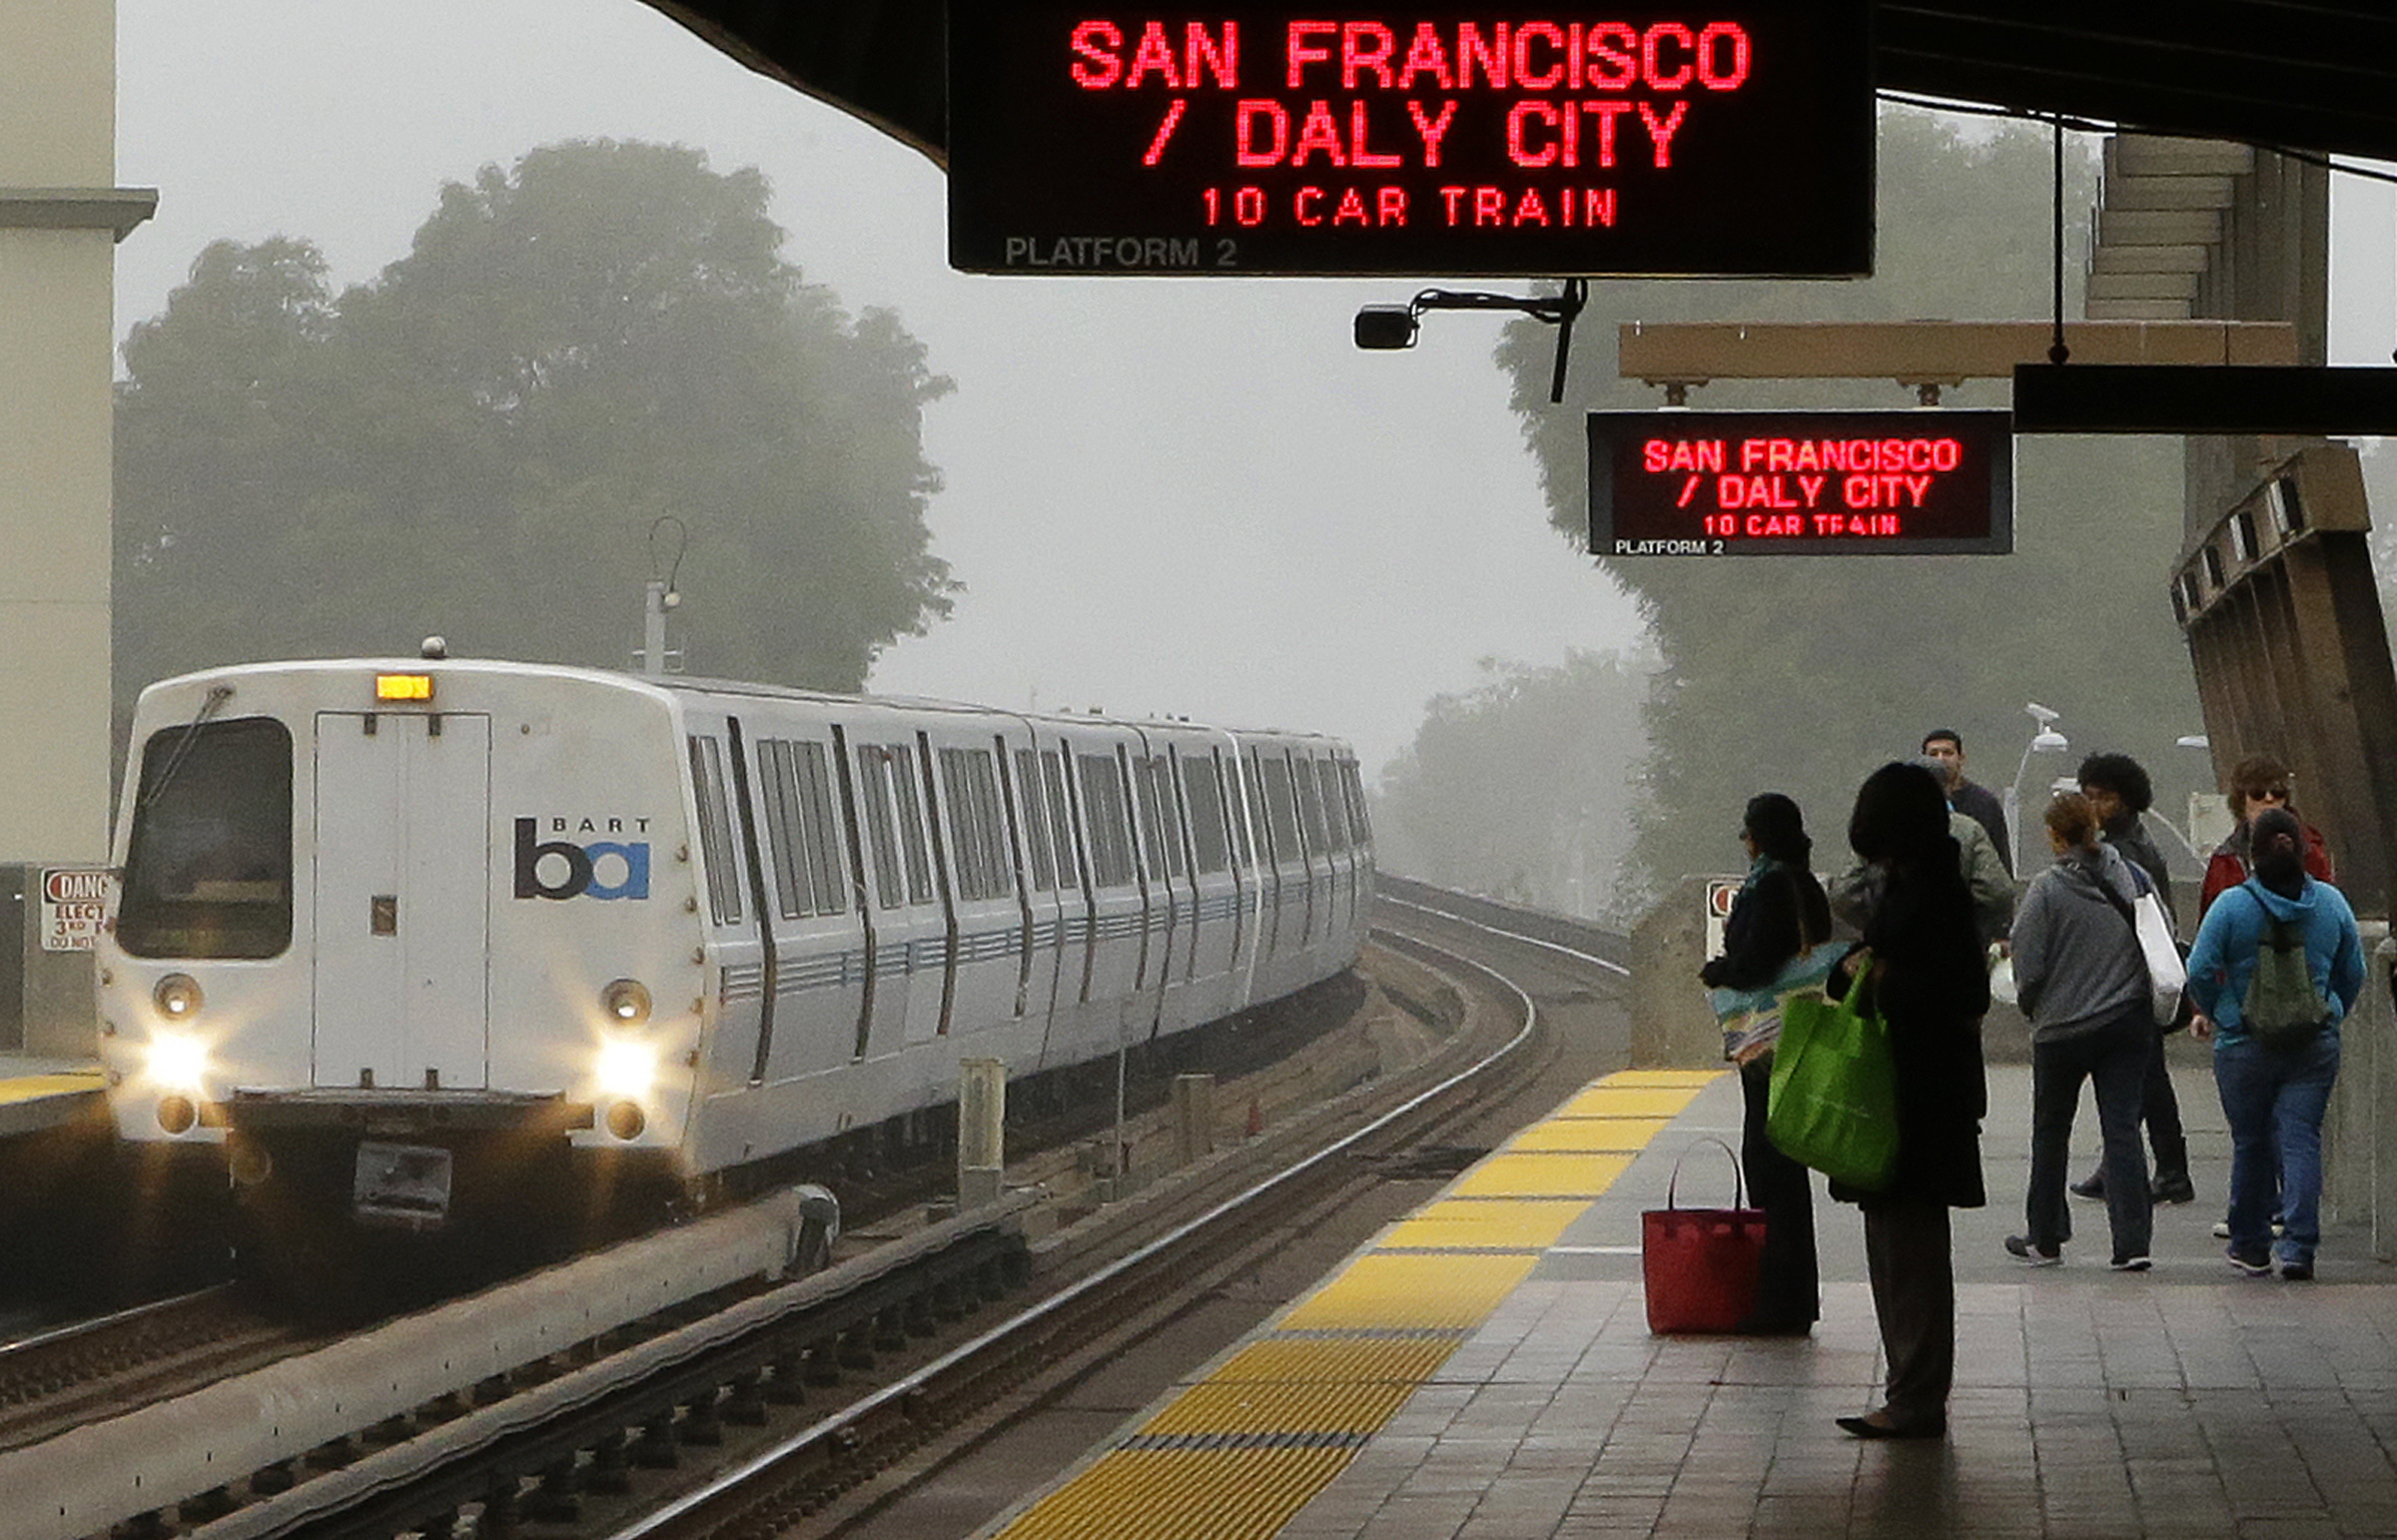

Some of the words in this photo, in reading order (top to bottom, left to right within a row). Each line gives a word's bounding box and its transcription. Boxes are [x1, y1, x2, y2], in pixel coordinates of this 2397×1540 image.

[1070, 20, 1239, 90] SAN
[1285, 20, 1753, 91] FRANCISCO
[1143, 99, 1187, 167] /
[1235, 99, 1458, 169] DALY
[1506, 100, 1689, 169] CITY
[1203, 186, 1265, 227] 10
[1294, 186, 1409, 227] CAR
[1440, 186, 1616, 228] TRAIN
[1006, 237, 1198, 266] PLATFORM
[1216, 238, 1237, 267] 2
[1643, 439, 1725, 472] SAN
[1740, 438, 1961, 472] FRANCISCO
[1677, 475, 1701, 507] /
[1717, 474, 1826, 509] DALY
[1842, 474, 1935, 508] CITY
[1704, 514, 1736, 535] 10
[1746, 514, 1804, 535] CAR
[1812, 514, 1901, 535] TRAIN
[1616, 539, 1707, 554] PLATFORM
[1713, 539, 1724, 554] 2
[552, 818, 650, 832] BART
